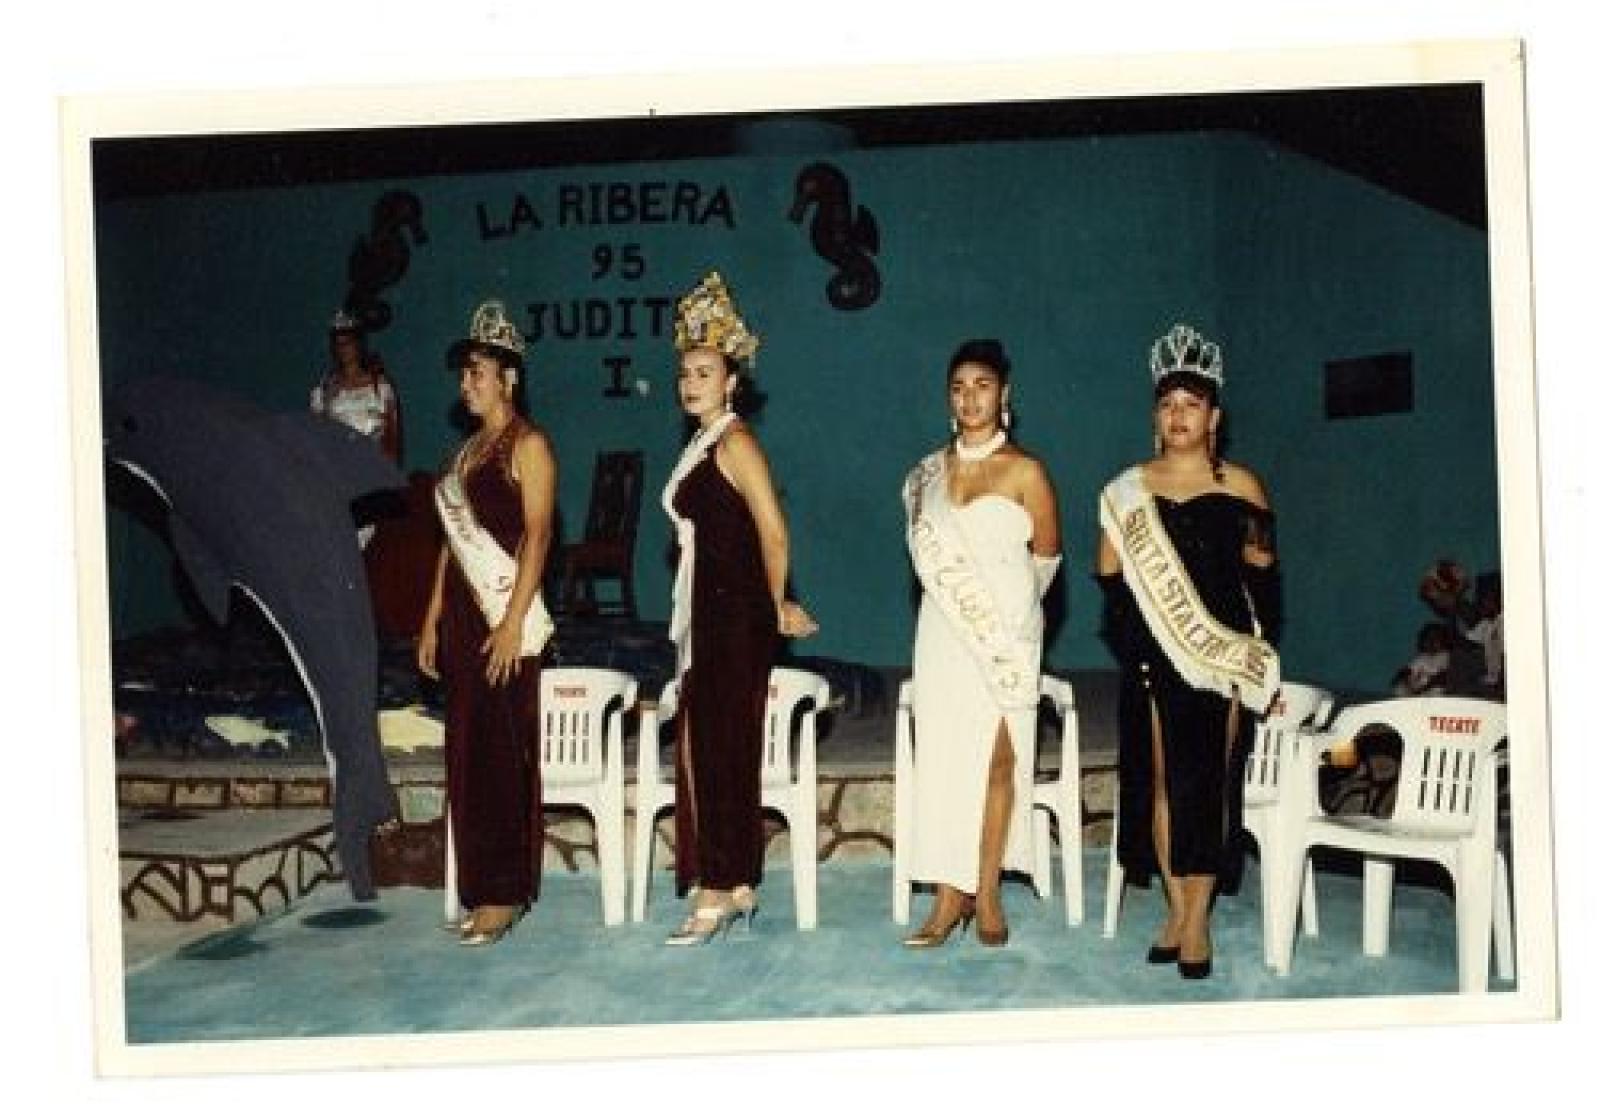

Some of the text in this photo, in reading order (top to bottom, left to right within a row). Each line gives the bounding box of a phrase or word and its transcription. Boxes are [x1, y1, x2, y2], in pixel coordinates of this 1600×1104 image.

[477, 181, 736, 240] LA RIBERA
[591, 242, 644, 280] 95
[525, 296, 679, 343] JUDIT
[603, 357, 631, 397] I
